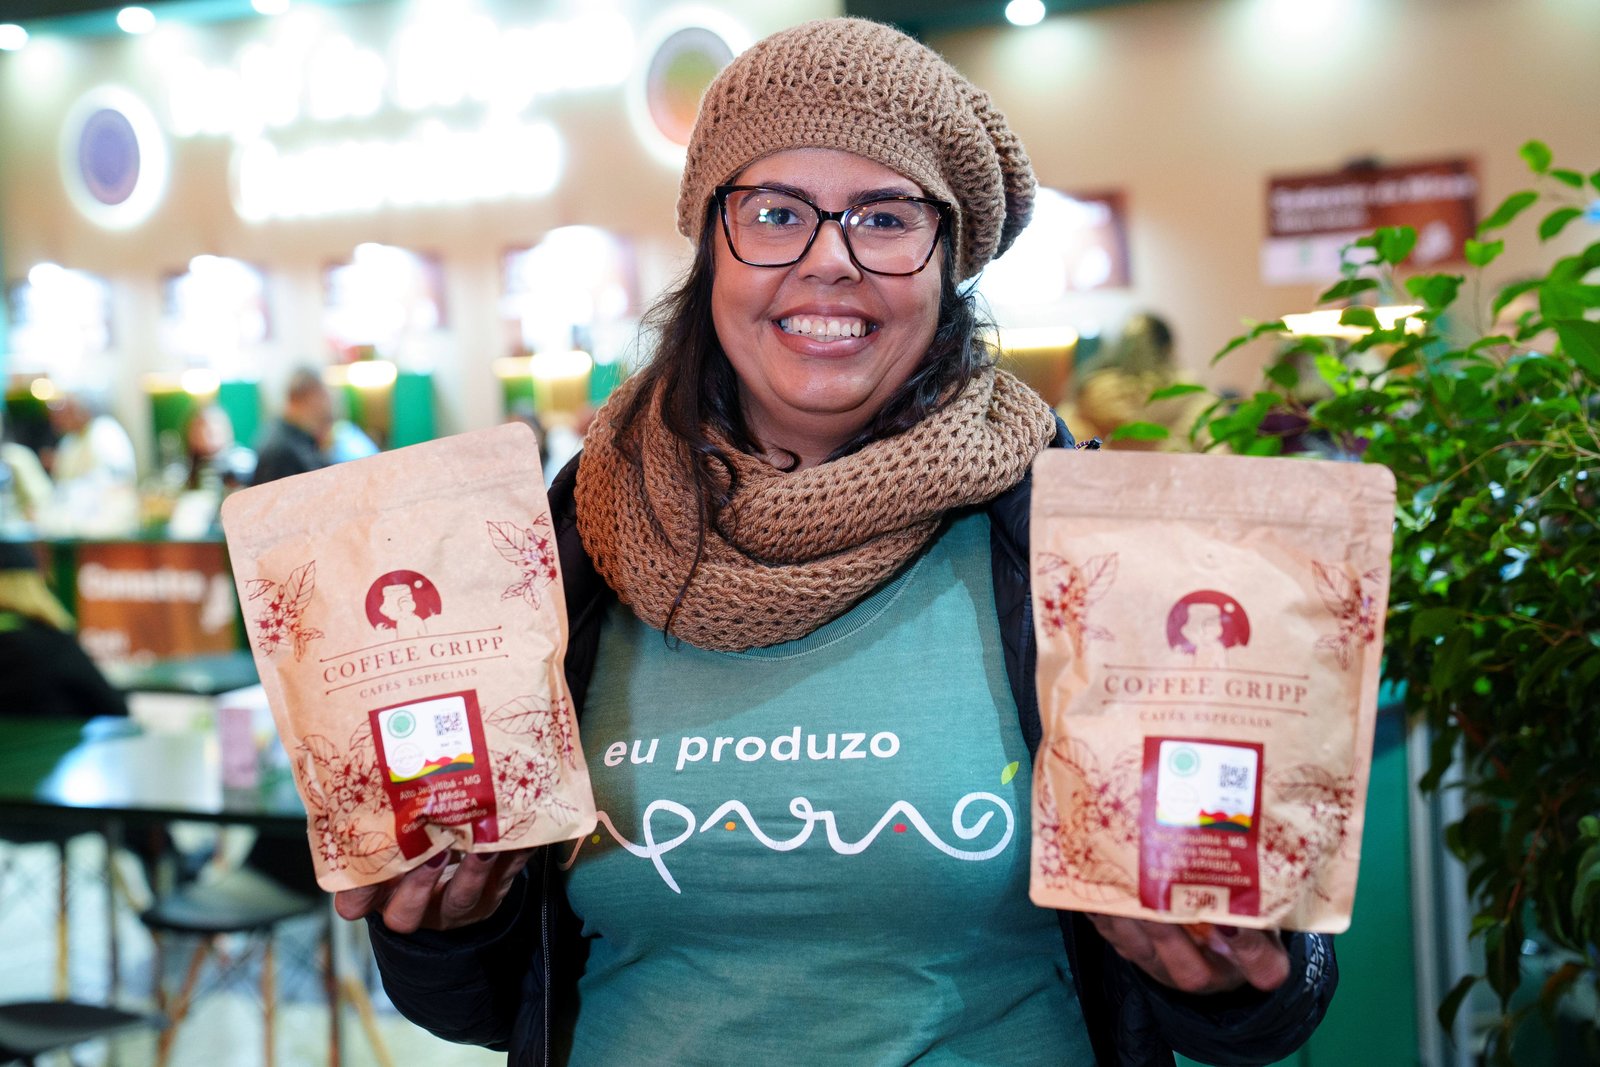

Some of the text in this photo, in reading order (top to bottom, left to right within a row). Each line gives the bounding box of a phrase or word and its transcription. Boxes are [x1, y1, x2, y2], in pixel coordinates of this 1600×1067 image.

[323, 636, 504, 683] COFFEE GRIPP
[408, 666, 478, 687] ESPECIAIS
[1104, 675, 1308, 704] COFFEE GRIPP
[603, 727, 901, 770] eu produzo
[464, 774, 481, 787] MG
